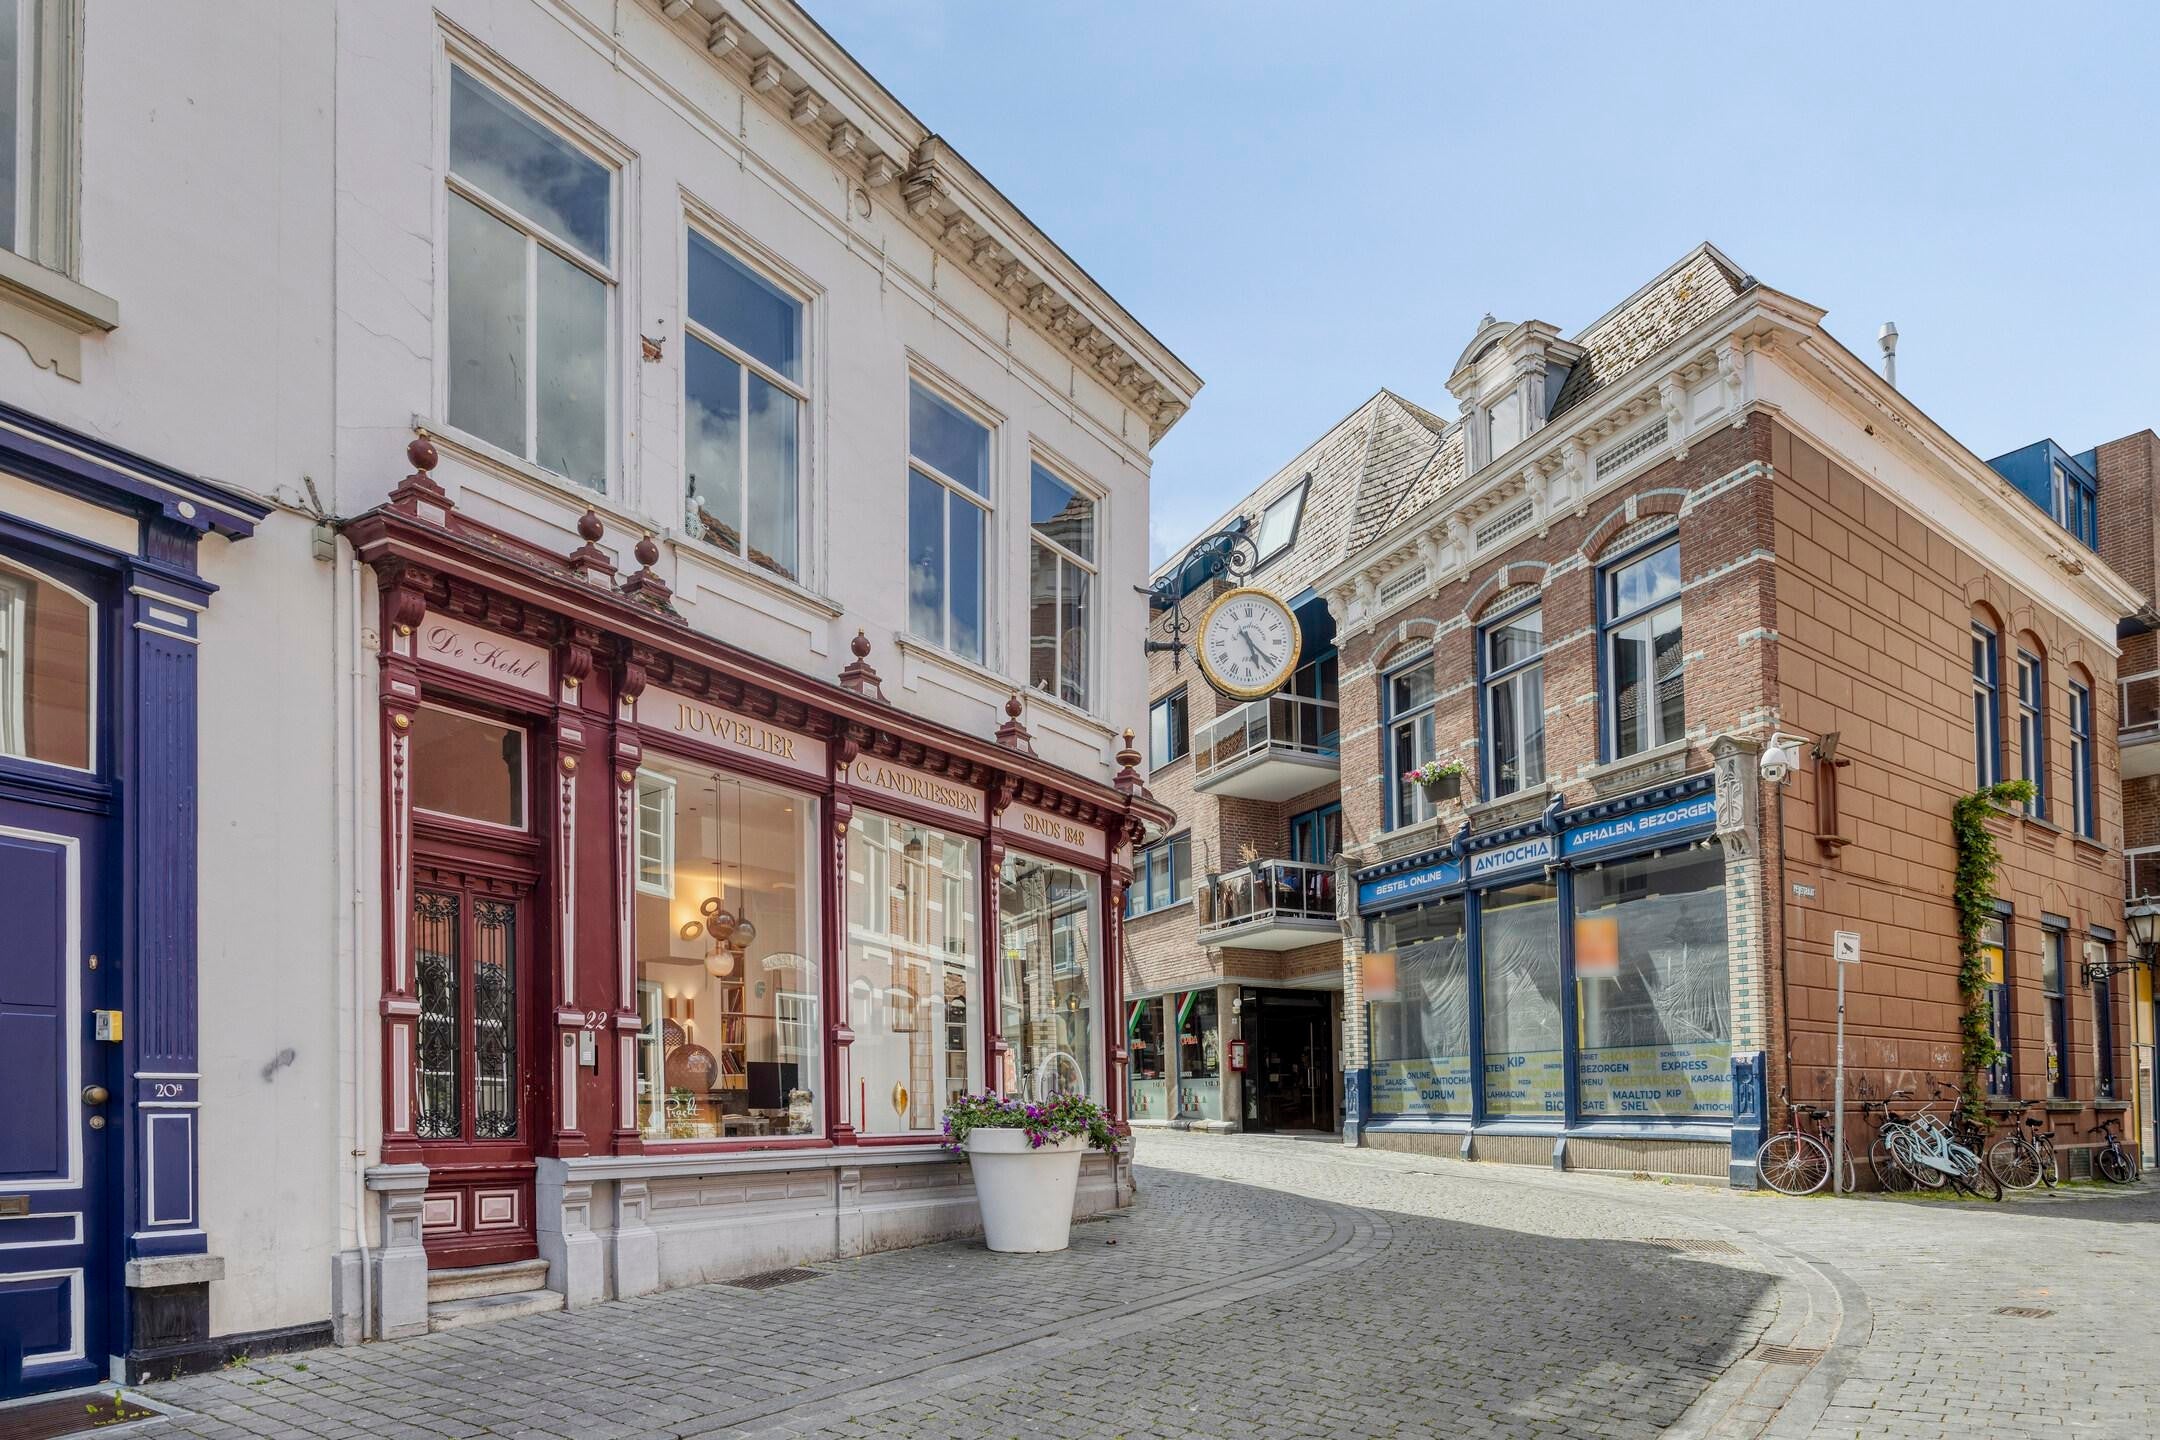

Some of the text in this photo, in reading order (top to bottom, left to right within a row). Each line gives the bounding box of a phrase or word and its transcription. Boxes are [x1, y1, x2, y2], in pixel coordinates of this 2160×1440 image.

[427, 626, 541, 679] De Ketel
[674, 703, 797, 761] JUWELIER
[856, 761, 977, 814] C. ANDRIESSEN
[1572, 801, 1717, 846] AFHALEN, BEZORGEN
[1023, 812, 1085, 847] SINDS 1848
[1475, 841, 1550, 871] ANTIOCHIA
[1376, 870, 1442, 895] BESTEL ONLINE
[584, 1010, 608, 1030] 22
[1507, 1056, 1526, 1068] KIP
[1661, 1060, 1708, 1071] EXPRESS
[1580, 1063, 1629, 1074] BEZORGEN
[1407, 1071, 1431, 1080] ONLINE
[1431, 1076, 1471, 1086] ANTIOCHIA
[1581, 1079, 1604, 1087] MENU
[1421, 1090, 1455, 1100] DURUM
[1487, 1091, 1526, 1099] LAHMACUN
[1612, 1090, 1661, 1100] MAALTIJD
[1666, 1088, 1682, 1098] KIP
[664, 1096, 705, 1119] Pracht
[1582, 1101, 1605, 1110] SATE
[1621, 1101, 1649, 1111] SNEL
